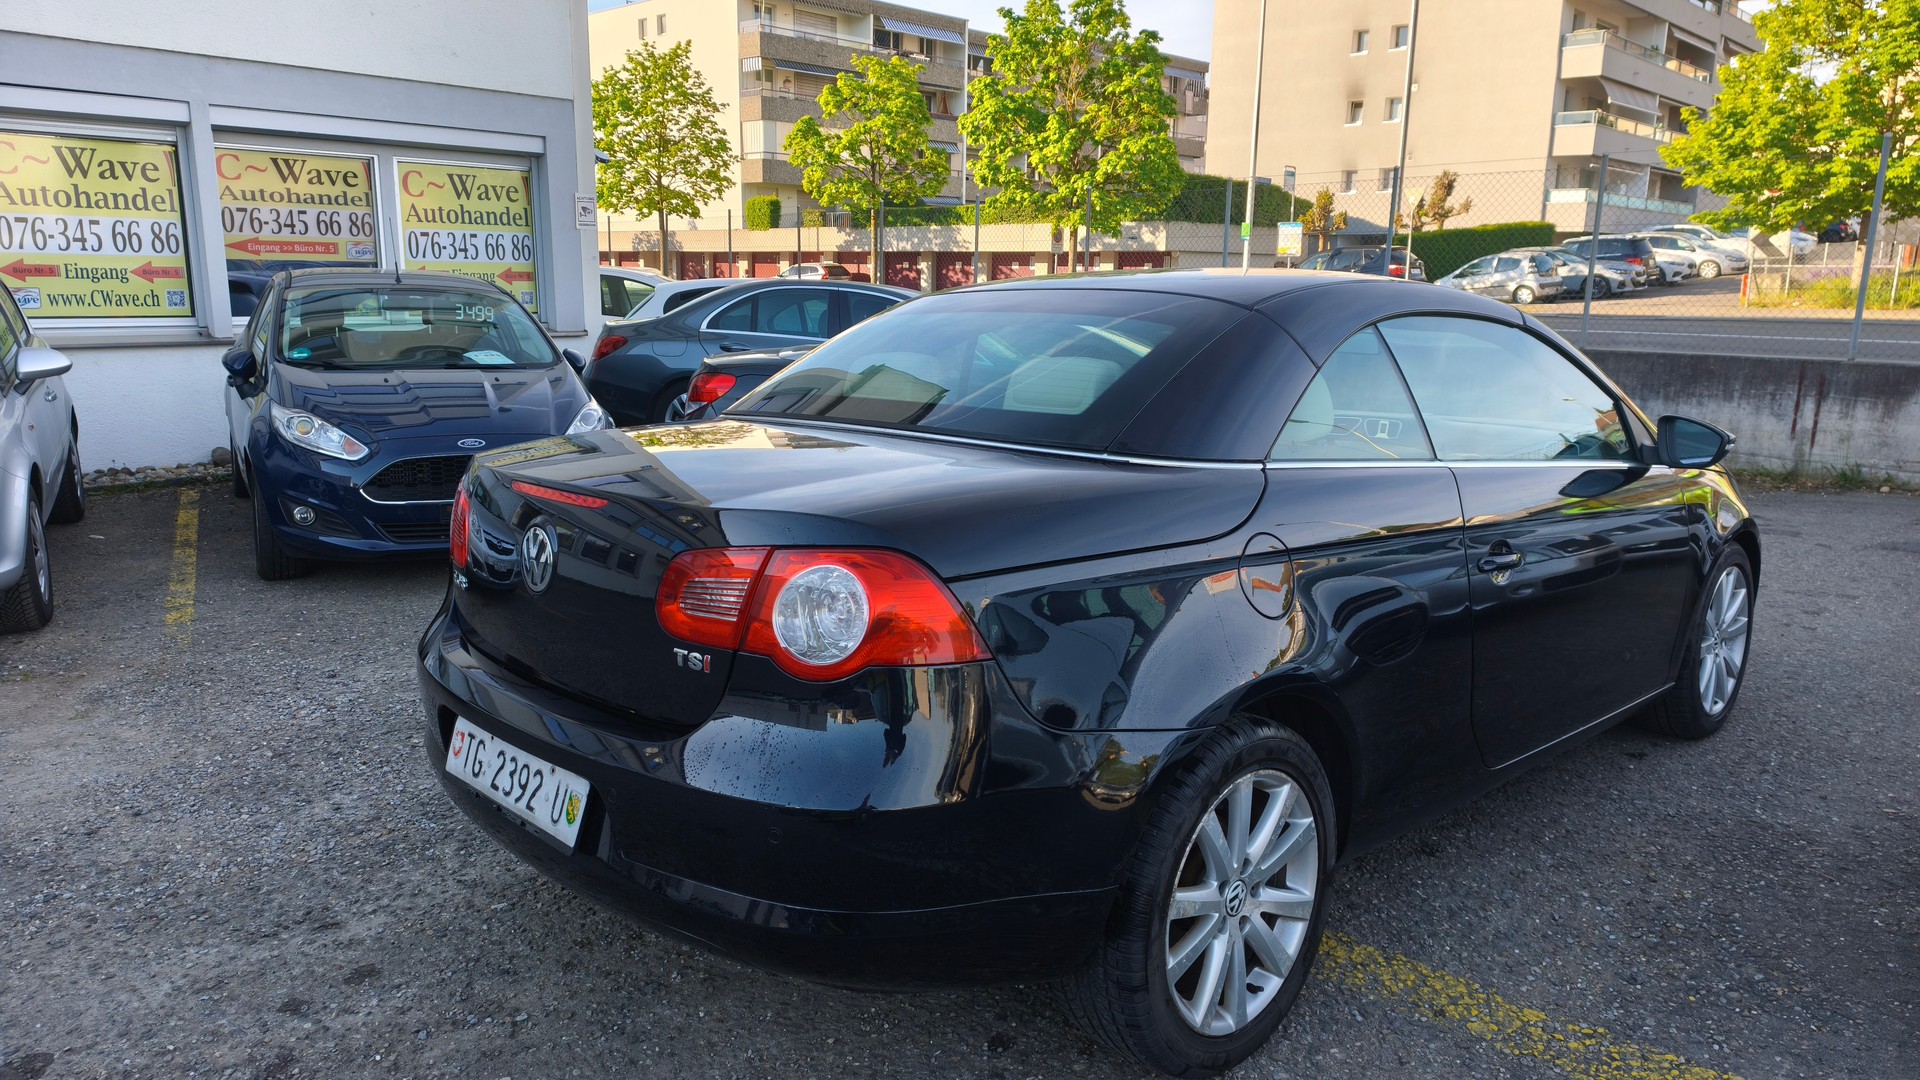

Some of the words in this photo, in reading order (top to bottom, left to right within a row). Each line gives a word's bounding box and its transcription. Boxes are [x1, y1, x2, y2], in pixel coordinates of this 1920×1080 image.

[220, 185, 372, 208] Autohandel
[221, 206, 309, 235] 076-345
[316, 210, 342, 237] 66
[349, 212, 373, 238] 86
[406, 202, 531, 227] Autohandel
[0, 215, 103, 252] 076-345
[111, 219, 143, 253] 66
[150, 221, 180, 254] 86
[408, 230, 479, 260] 076-345
[485, 233, 506, 261] 66
[511, 234, 531, 262] 86
[247, 242, 281, 253] Eingang
[294, 244, 314, 252] Büro
[315, 244, 329, 252] Nr.
[329, 245, 335, 253] 5
[63, 263, 129, 284] Eingang
[46, 289, 161, 308] www.CWave.ch
[455, 303, 494, 322] 3499
[673, 647, 711, 674] TSI
[463, 730, 487, 780] TG
[490, 749, 544, 813] 2392
[550, 779, 569, 824] U
